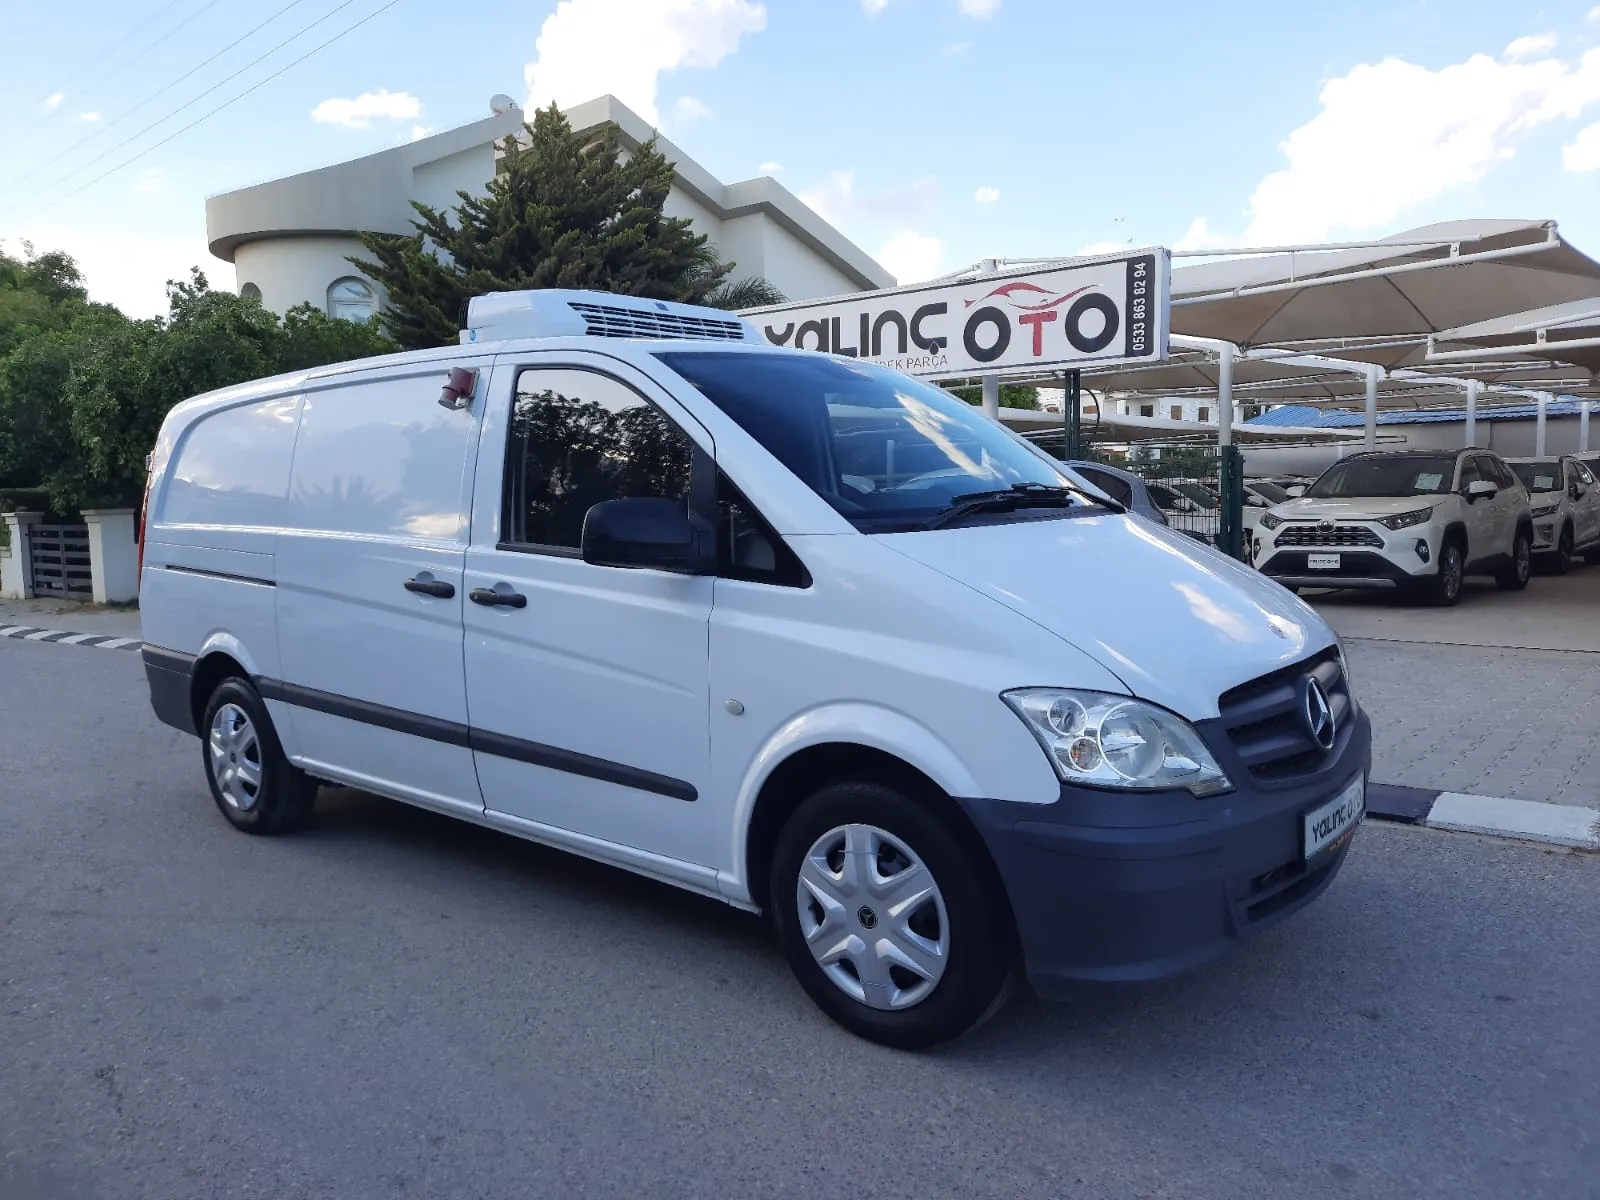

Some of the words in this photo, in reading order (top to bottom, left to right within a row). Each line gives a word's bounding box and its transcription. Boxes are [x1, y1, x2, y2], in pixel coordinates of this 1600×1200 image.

[1133, 262, 1147, 278] 94
[1133, 279, 1146, 295] 82
[1133, 297, 1146, 319] 863
[963, 292, 1120, 363] OTO
[1132, 322, 1146, 351] 0533
[906, 354, 948, 370] PARÇA
